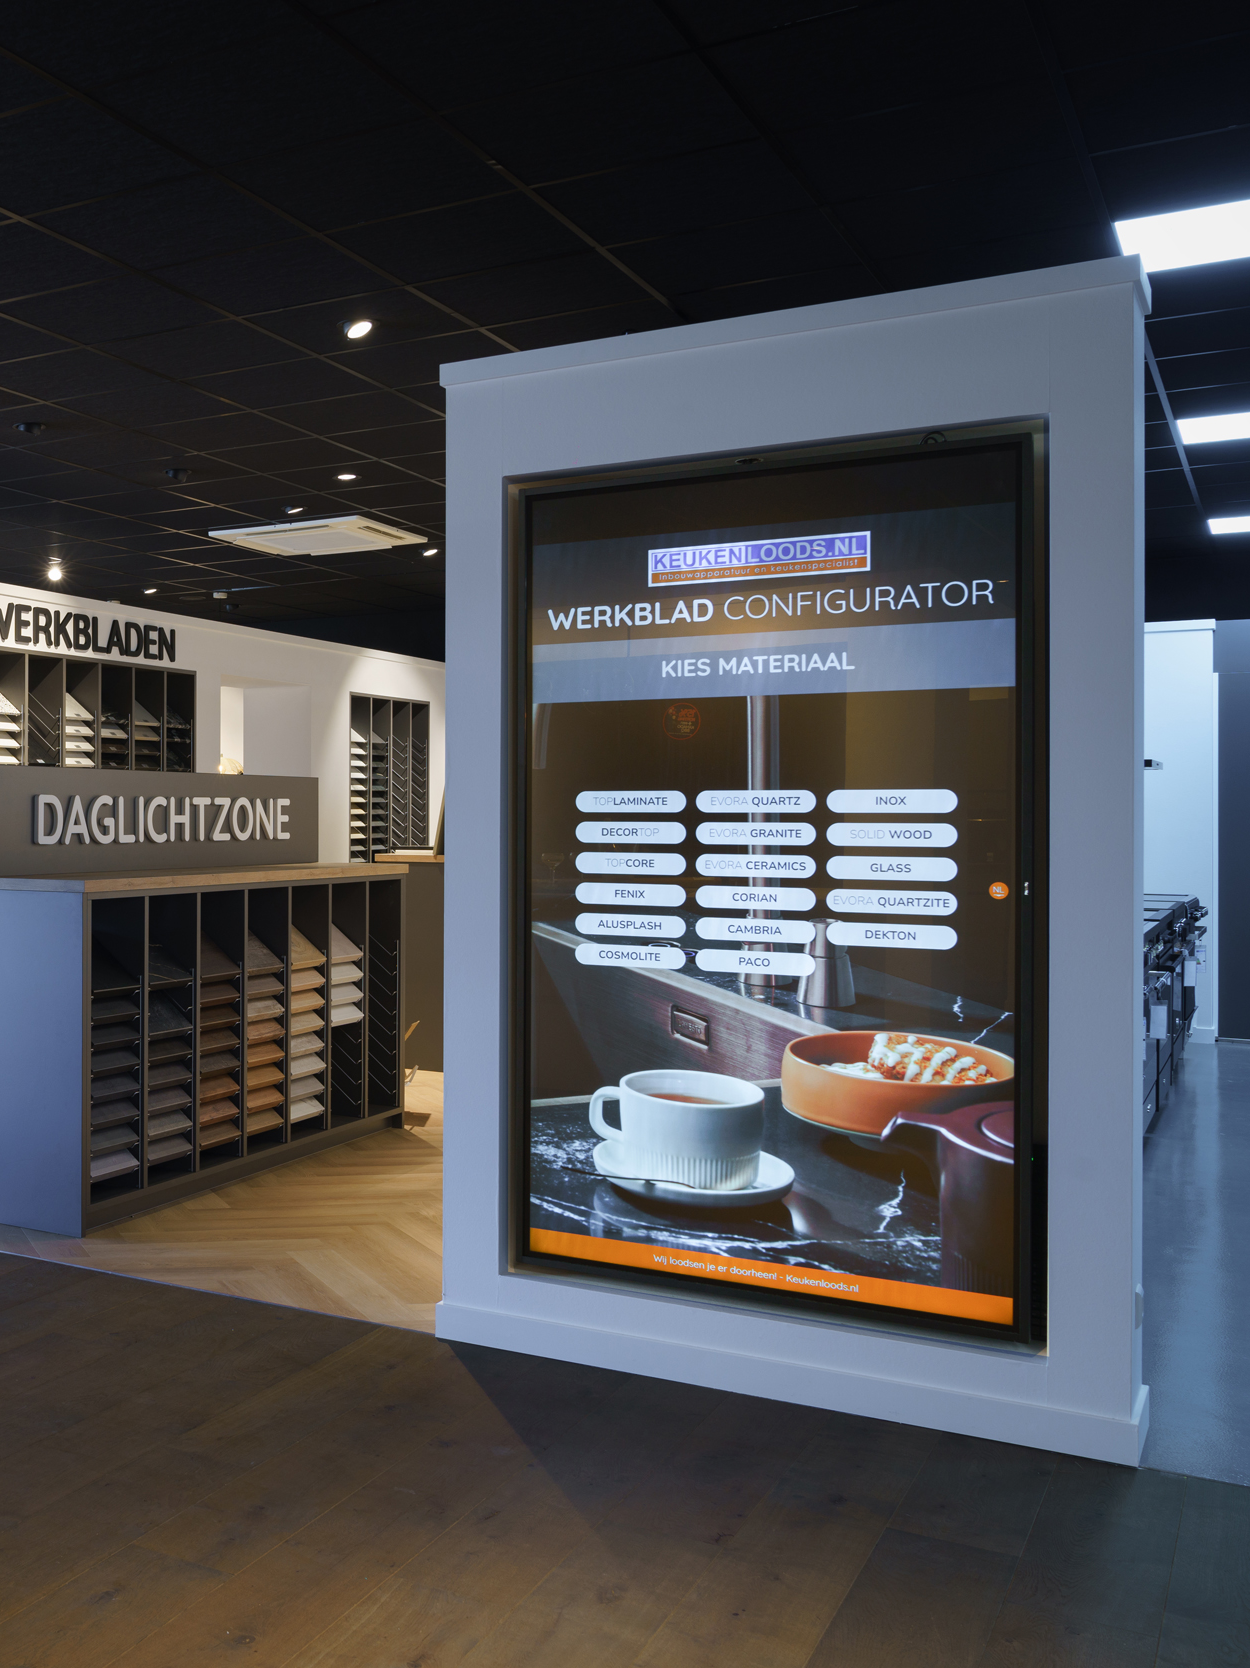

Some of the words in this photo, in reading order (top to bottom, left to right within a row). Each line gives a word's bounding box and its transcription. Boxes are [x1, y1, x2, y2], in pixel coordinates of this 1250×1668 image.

[653, 537, 865, 570] KEUKENLOODS.NL
[659, 567, 751, 581] Inbouwapparatuur
[754, 566, 767, 574] en
[770, 558, 859, 573] keukenspecialist
[548, 598, 714, 631] WERKBLAD
[723, 579, 995, 621] CONFIGURATOR
[661, 658, 711, 678] KIES
[718, 651, 856, 676] MATERIAAL
[593, 796, 668, 807] TOPLAMINATE
[710, 796, 749, 807] EVORA
[751, 796, 801, 808] QUARTZ
[875, 796, 907, 806] INOX
[34, 794, 291, 845] DAGLICHTZONE
[601, 827, 660, 838] DECORTOP
[709, 828, 747, 839] EVORA
[750, 828, 802, 839] GRANITE
[850, 829, 885, 840] SOLID
[889, 829, 933, 840] WOOD
[605, 858, 655, 869] TOPCORE
[704, 860, 743, 871] EVORA
[746, 860, 807, 872] CERAMICS
[870, 863, 912, 874] GLASS
[614, 888, 646, 900] FENIX
[732, 892, 778, 903] CORIAN
[833, 895, 874, 907] EVORA
[877, 896, 951, 909] QUARTZITE
[597, 920, 663, 931] ALUSPLASH
[727, 924, 783, 936] CAMBRIA
[865, 930, 917, 942] DEKTON
[598, 950, 661, 962] COSMOLITE
[738, 956, 771, 968] PACO
[653, 1254, 667, 1265] Wij
[669, 1256, 705, 1270] loodsen
[706, 1261, 716, 1272] je
[717, 1265, 728, 1273] er
[730, 1265, 778, 1281] doorheen!
[786, 1274, 859, 1293] Keukenloods.nl
